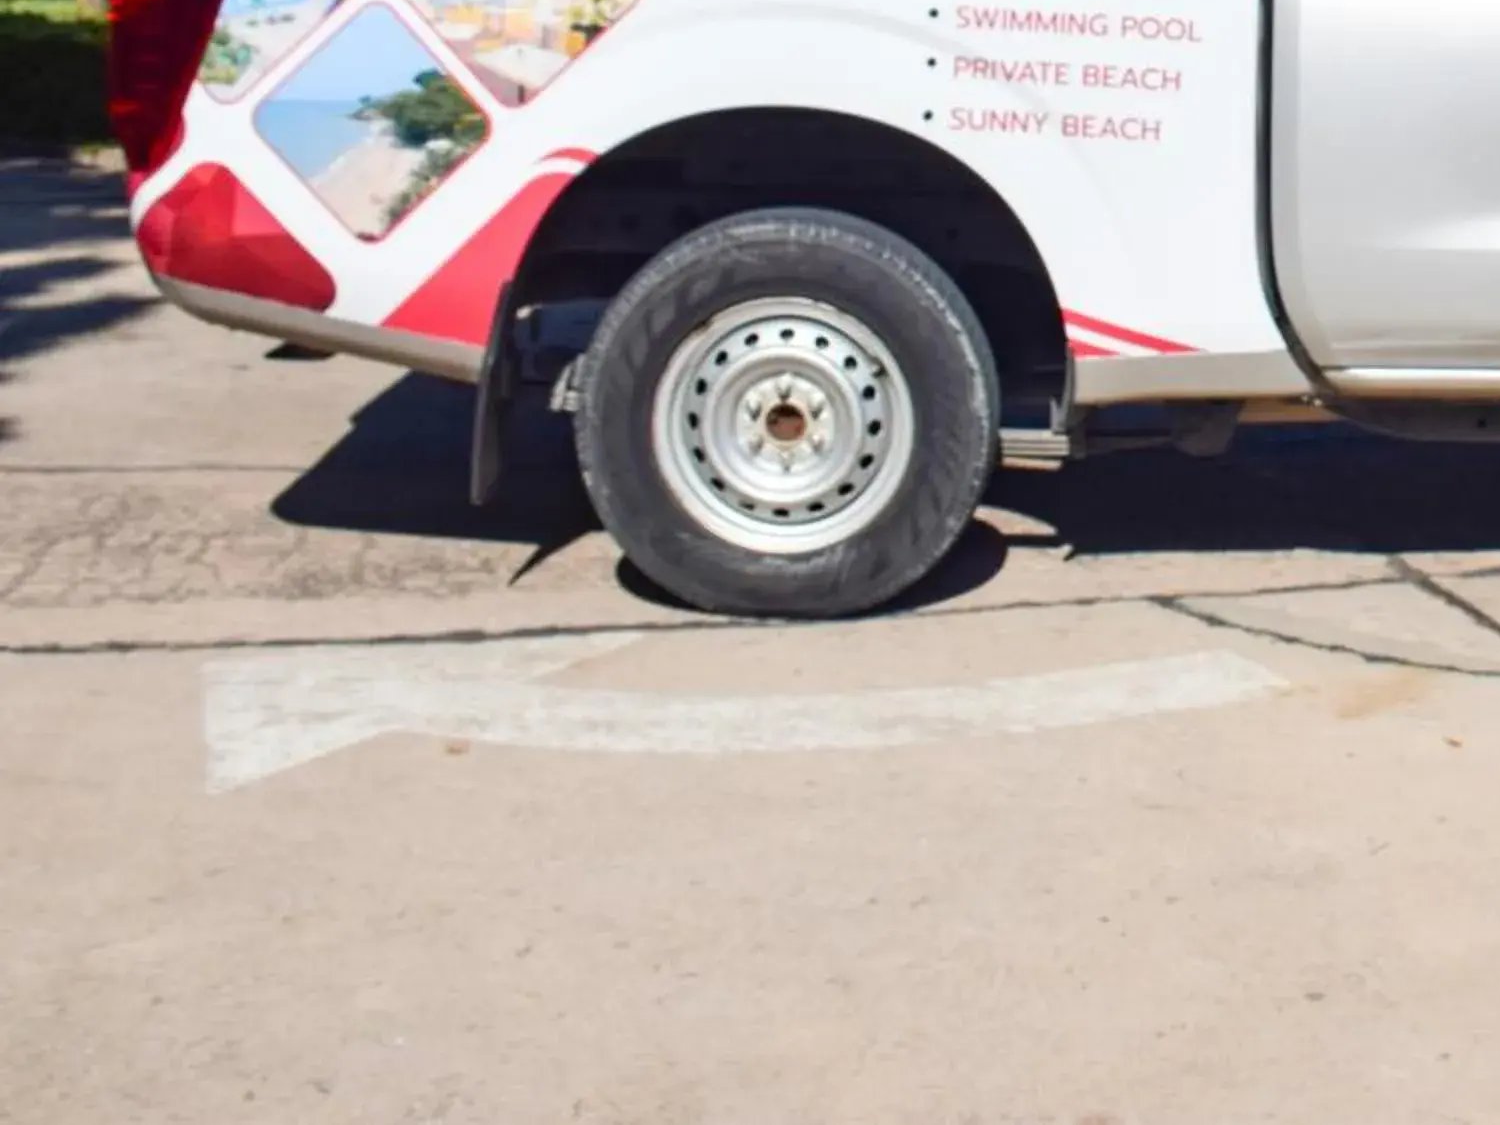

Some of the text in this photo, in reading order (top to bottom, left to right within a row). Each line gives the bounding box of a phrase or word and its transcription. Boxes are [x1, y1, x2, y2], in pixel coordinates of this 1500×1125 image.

[955, 5, 1203, 43] SWIMMING POOL
[952, 55, 1182, 91] PRIVATE BEACH
[948, 106, 1163, 141] SUNNY BEACH
